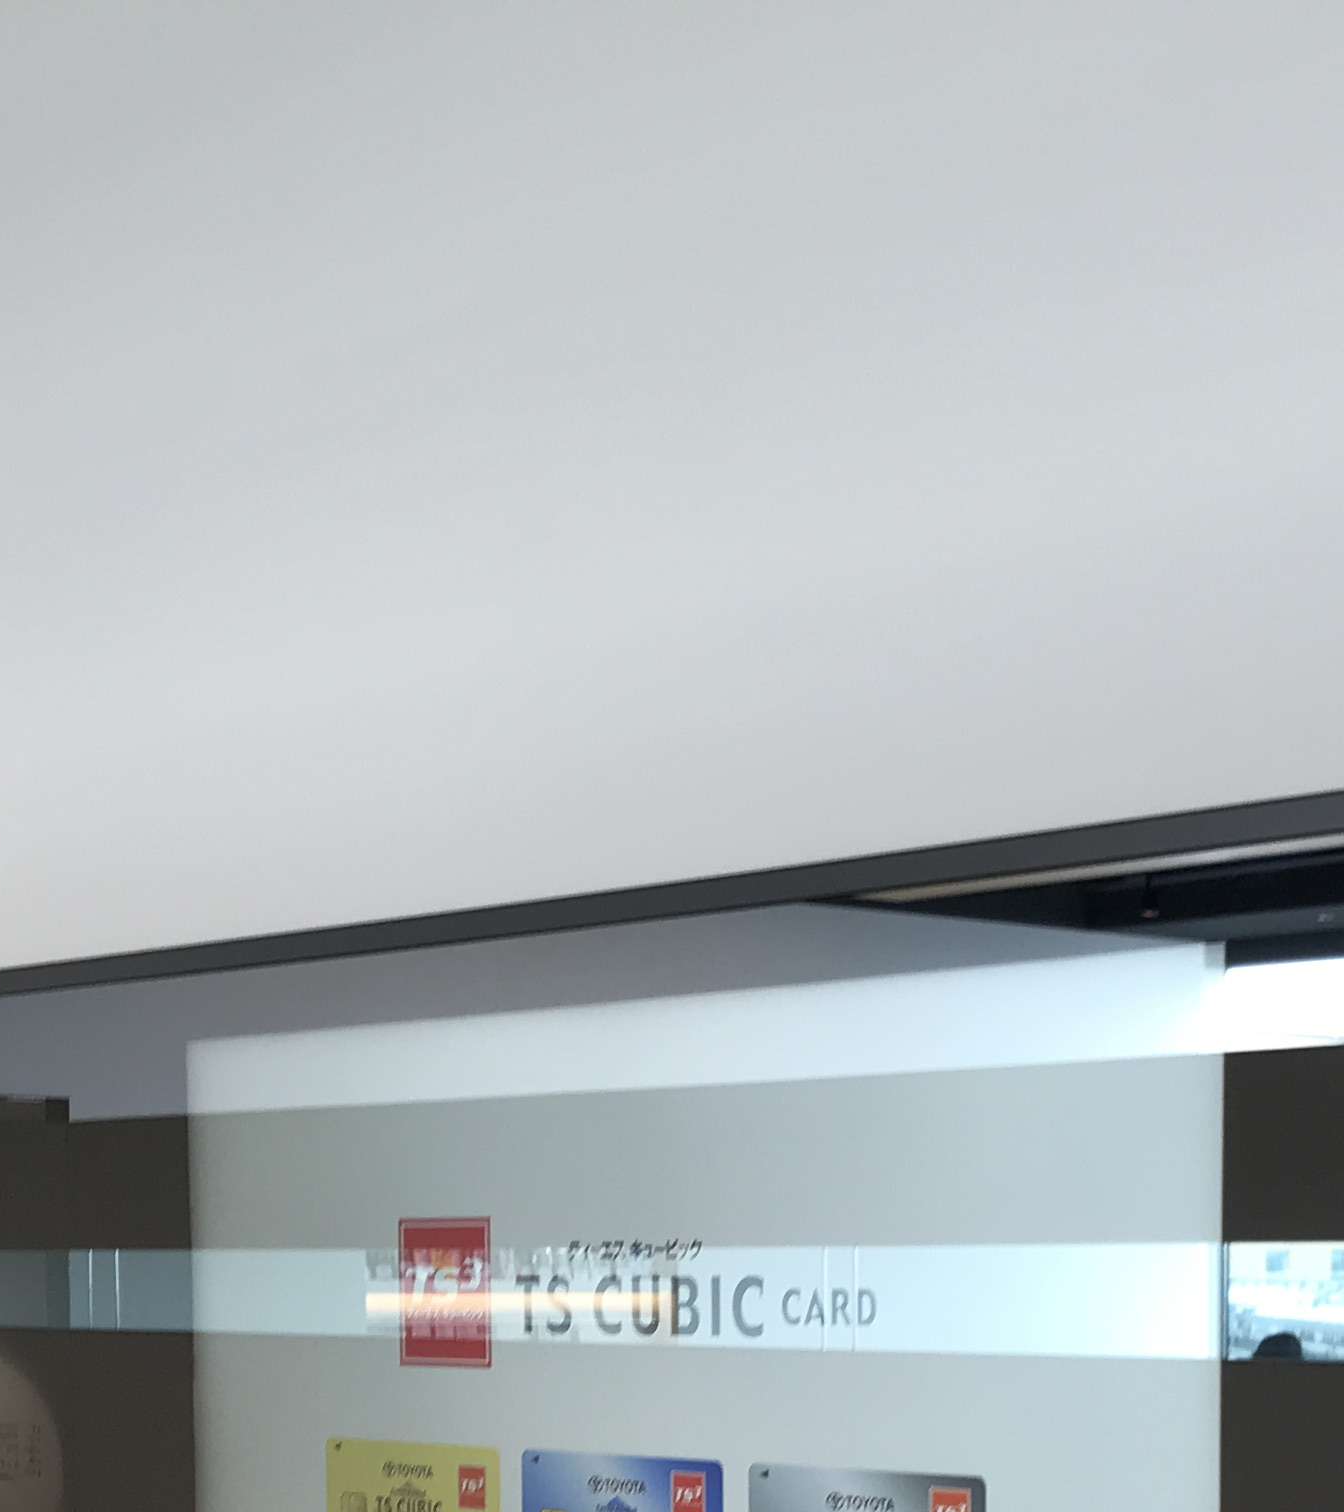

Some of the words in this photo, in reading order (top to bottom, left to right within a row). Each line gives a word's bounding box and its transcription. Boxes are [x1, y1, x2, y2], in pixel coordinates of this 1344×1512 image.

[515, 1273, 573, 1336] TS
[593, 1273, 765, 1339] CUBIC
[781, 1285, 878, 1328] CARD
